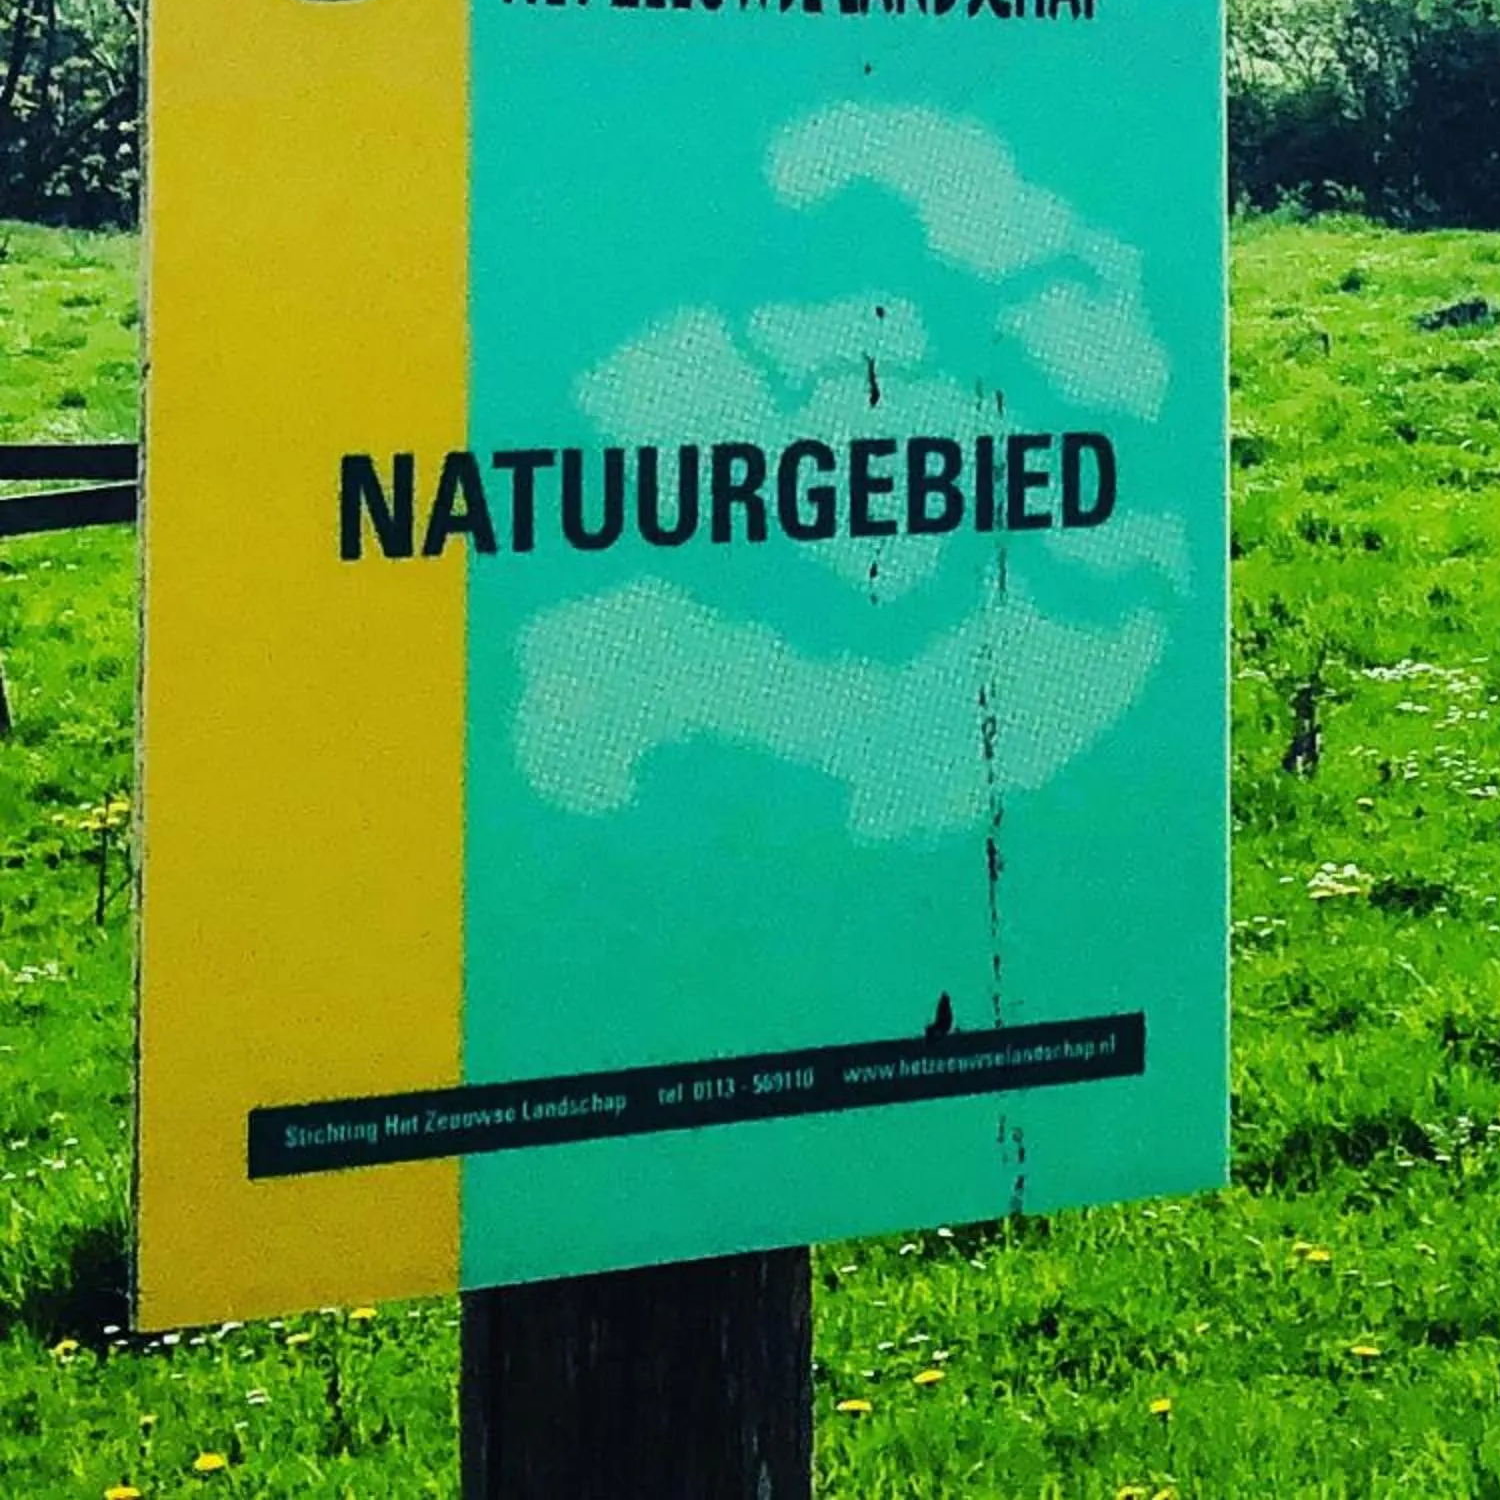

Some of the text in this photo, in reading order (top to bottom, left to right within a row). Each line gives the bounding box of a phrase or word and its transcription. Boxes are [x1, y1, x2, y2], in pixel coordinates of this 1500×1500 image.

[338, 430, 1118, 562] NATUURGEBIED
[284, 1121, 379, 1149] Stichting
[385, 1112, 419, 1137] Het
[424, 1106, 517, 1134] Zeeuwse
[521, 1092, 628, 1122] Landschap
[657, 1082, 684, 1106] tel
[693, 1076, 736, 1101] 0113
